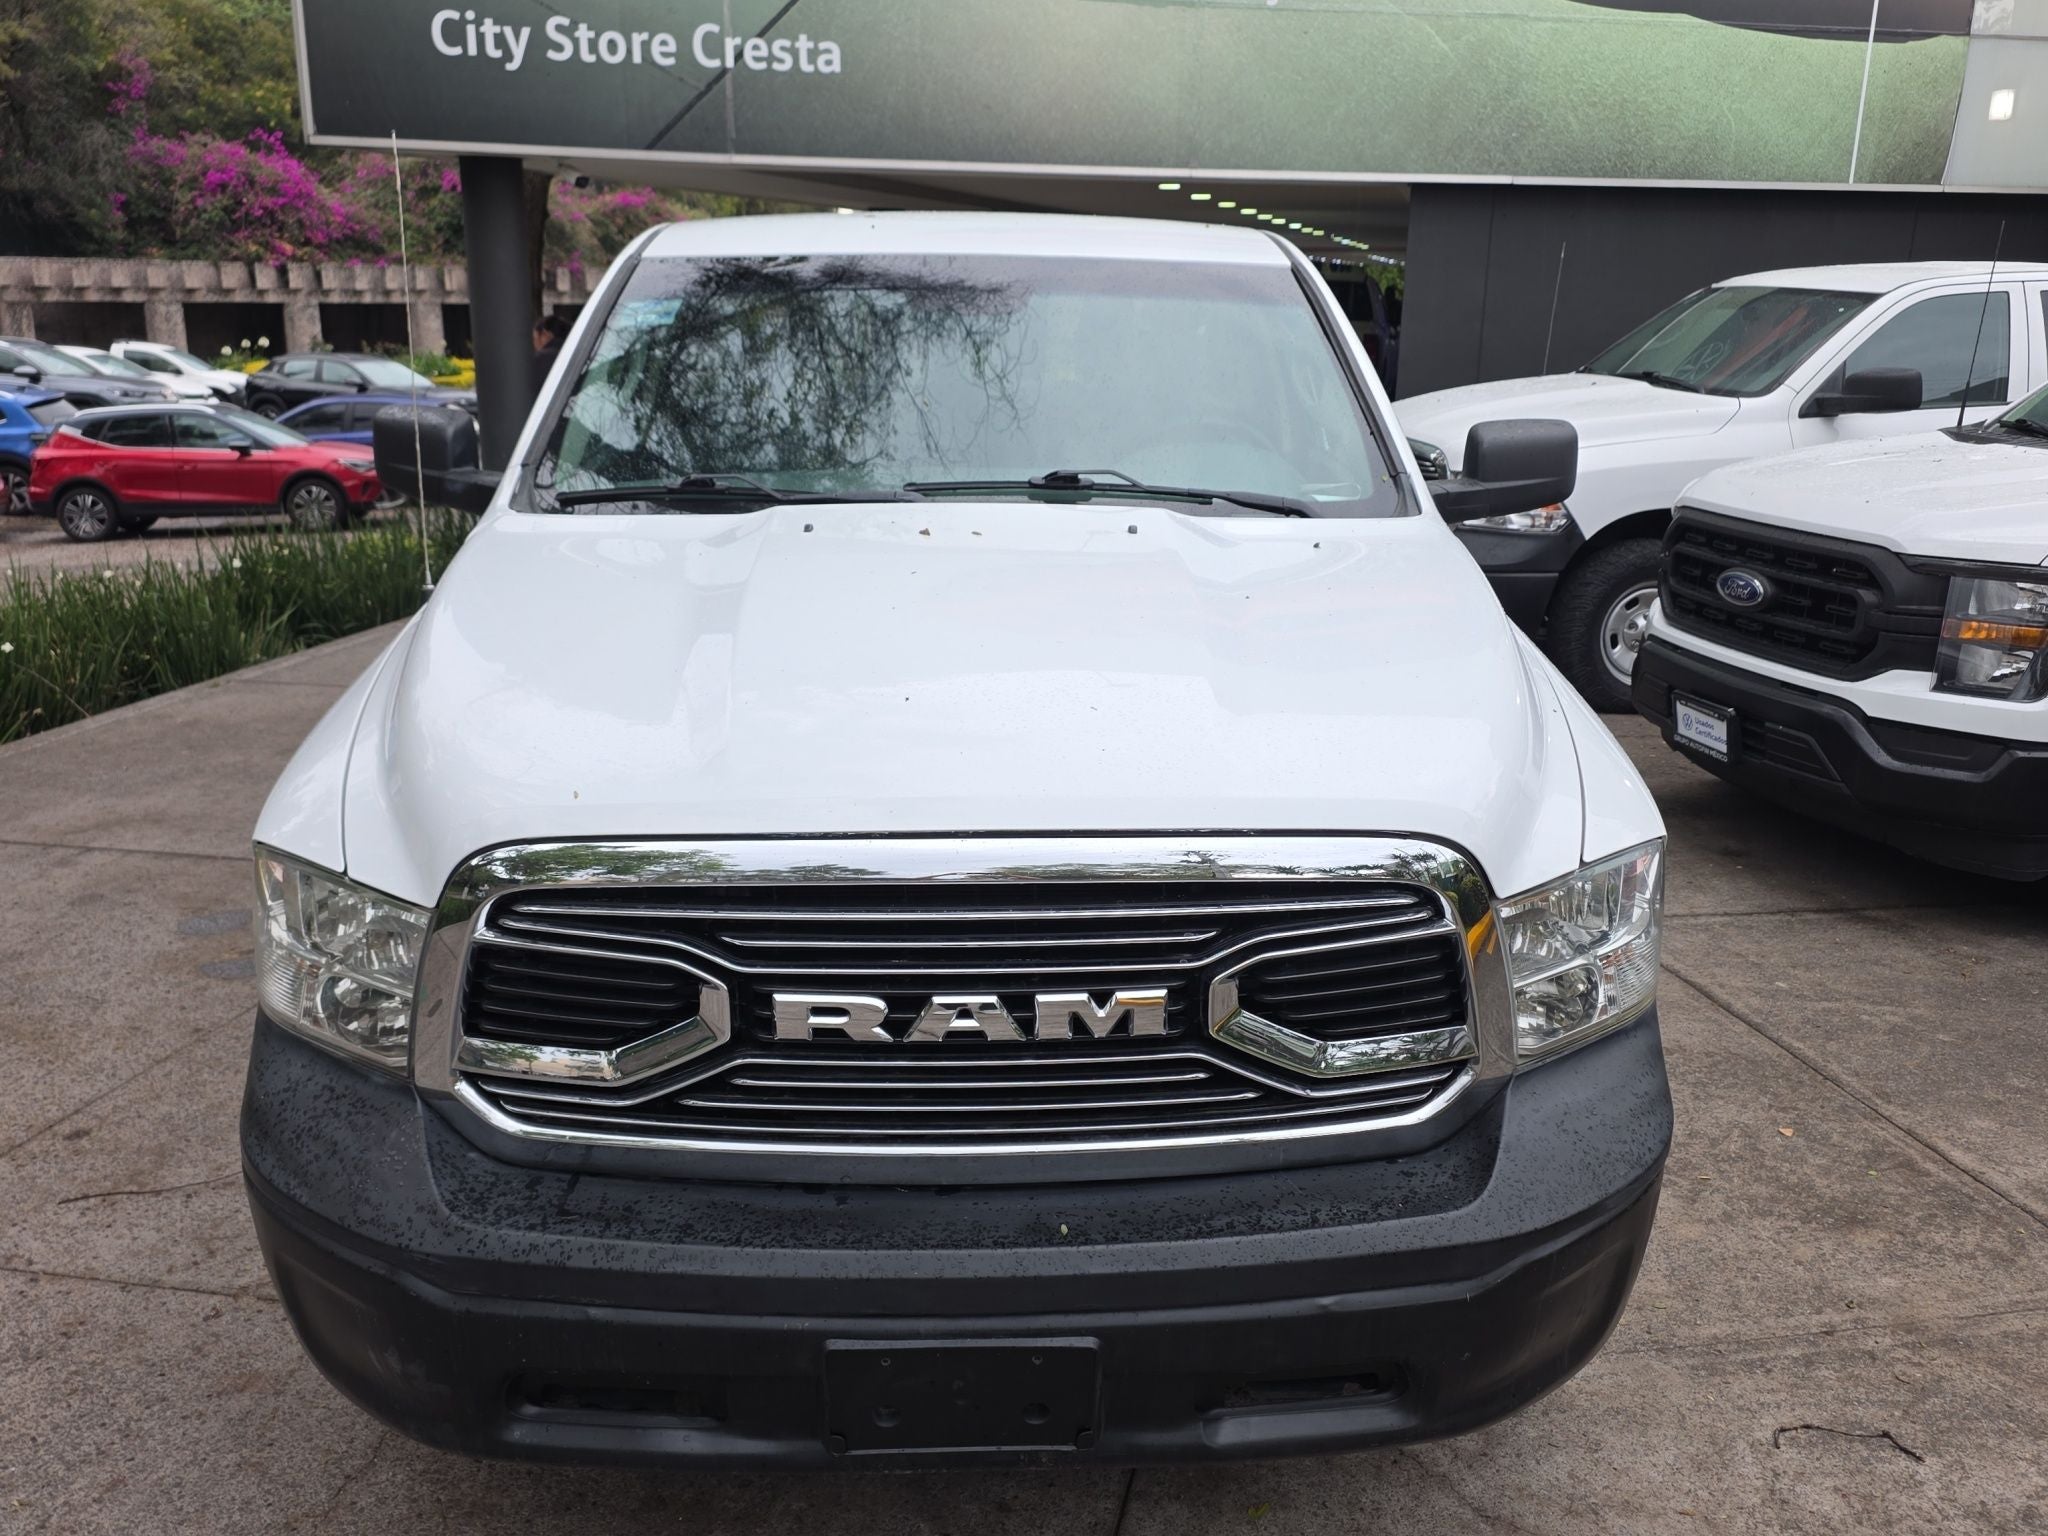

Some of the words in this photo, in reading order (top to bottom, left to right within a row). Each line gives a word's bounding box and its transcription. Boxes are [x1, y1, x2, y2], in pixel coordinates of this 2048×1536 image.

[430, 9, 531, 71] City
[545, 15, 678, 66] Store
[692, 22, 842, 74] Cresta
[1724, 579, 1751, 599] Ford
[1695, 717, 1715, 730] Usados
[1695, 727, 1728, 746] Certificados
[772, 989, 1168, 1043] RAM
